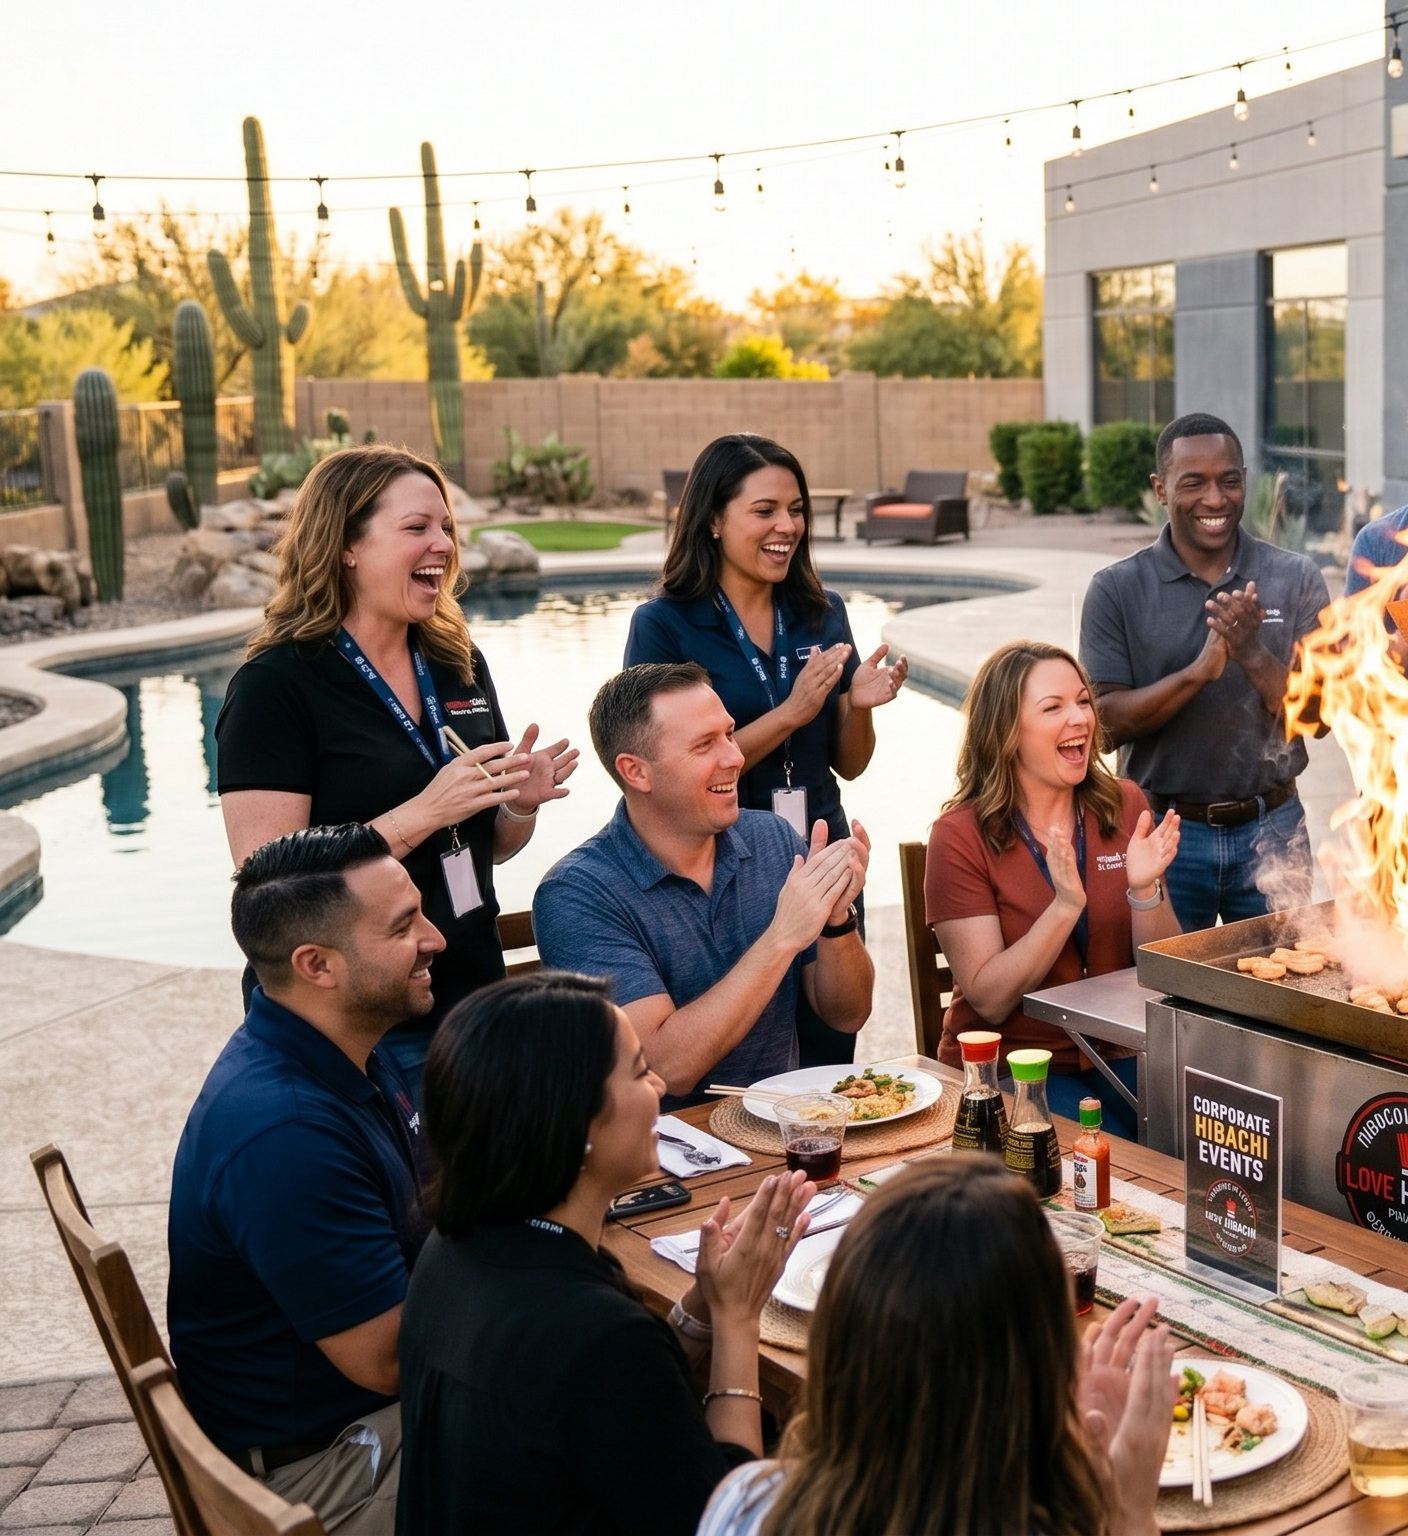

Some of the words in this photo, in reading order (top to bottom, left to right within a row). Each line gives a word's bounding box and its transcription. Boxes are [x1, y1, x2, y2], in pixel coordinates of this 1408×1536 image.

[1193, 1095, 1270, 1136] CORPORATE
[1195, 1113, 1268, 1160] HIBACHI
[1199, 1139, 1264, 1182] EVENTS
[1346, 1162, 1394, 1201] LOVE
